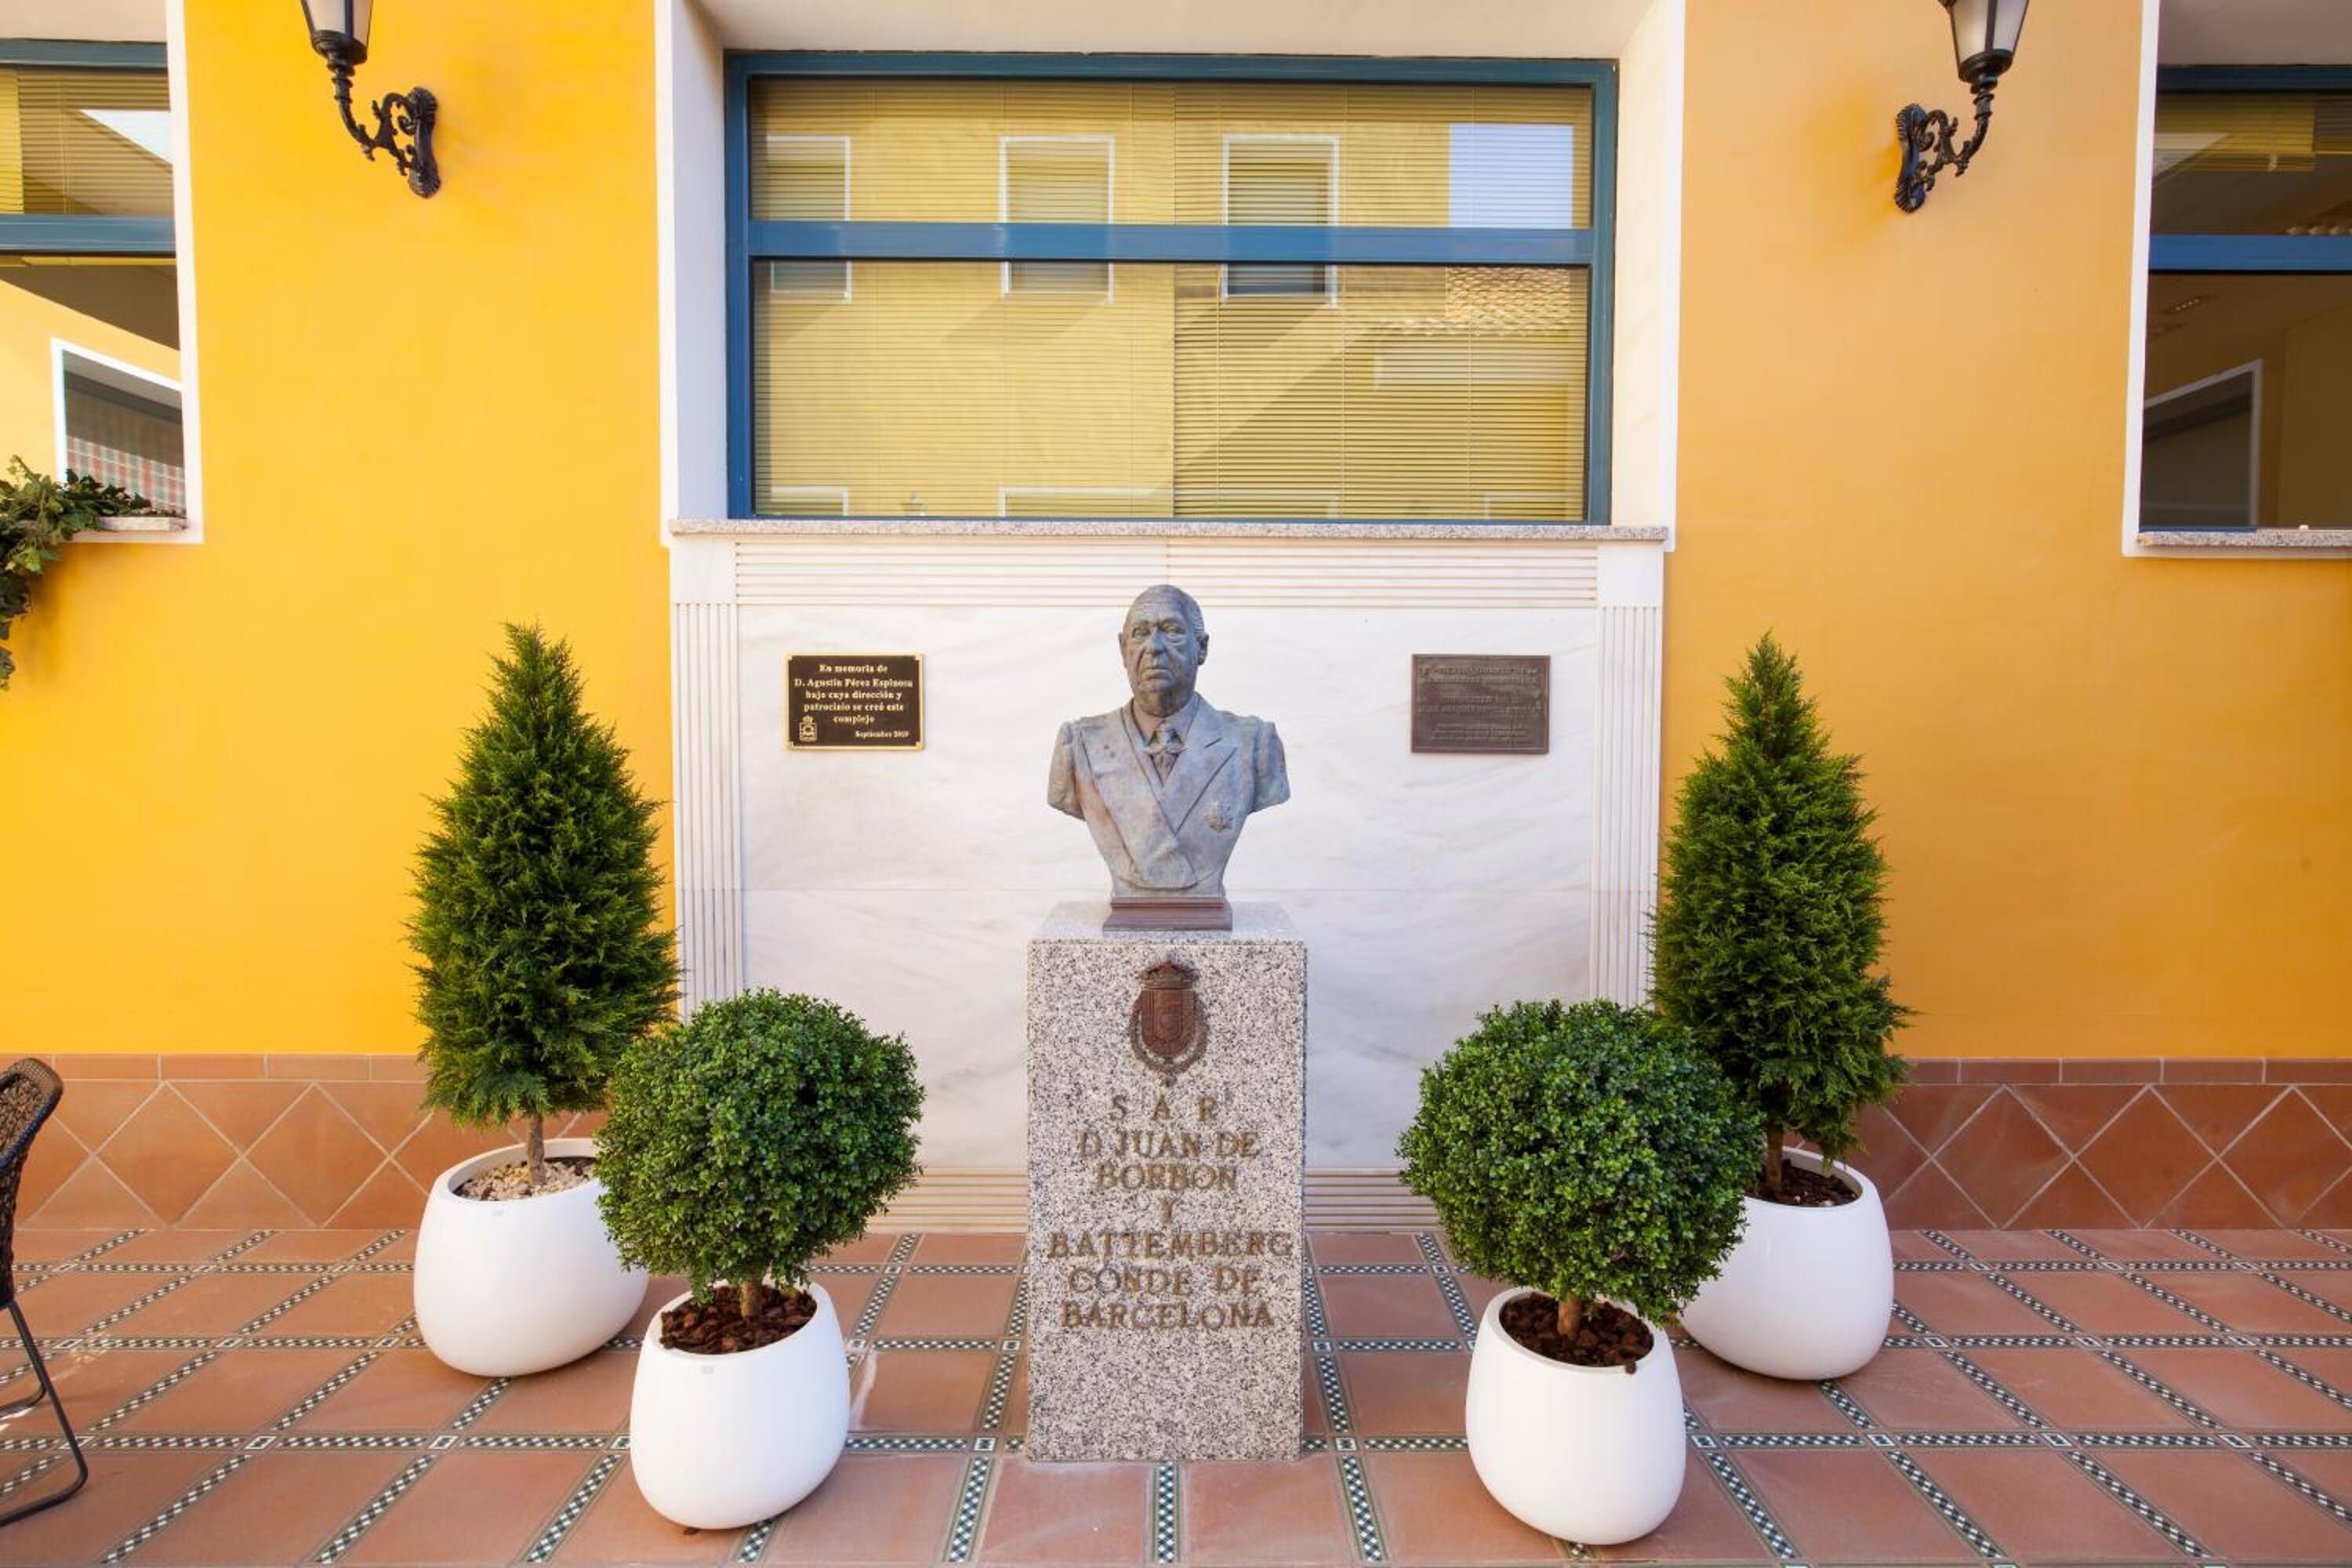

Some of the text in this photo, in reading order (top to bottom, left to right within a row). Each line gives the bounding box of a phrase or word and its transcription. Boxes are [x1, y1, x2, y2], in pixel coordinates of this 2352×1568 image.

[819, 664, 887, 673] En memoria de
[794, 678, 805, 687] D.
[845, 678, 870, 687] Pérez
[873, 678, 913, 688] Espinosa
[805, 690, 826, 700] bajo
[852, 690, 894, 699] dirección
[804, 702, 851, 712] patrocinio
[833, 714, 876, 724] complejo
[1111, 1093, 1218, 1122] S A R
[1110, 1131, 1203, 1159] JUAN
[1214, 1131, 1261, 1158] DE
[1093, 1161, 1238, 1190] BORBON
[1159, 1197, 1179, 1223] Y
[1047, 1231, 1292, 1258] BATTEMBERG
[1066, 1268, 1261, 1295] CONDE DE
[1060, 1302, 1274, 1329] BARCELONA
